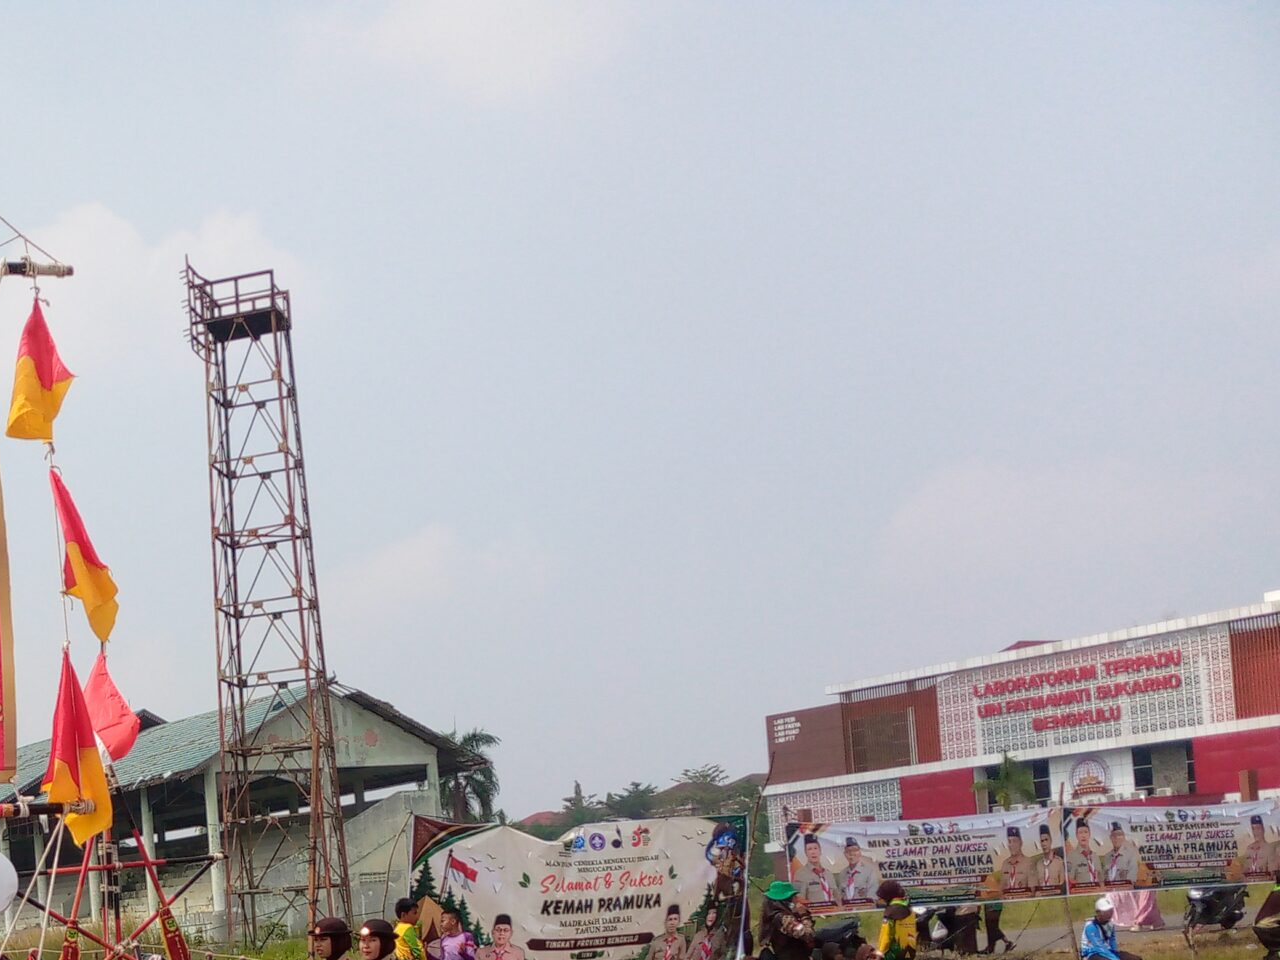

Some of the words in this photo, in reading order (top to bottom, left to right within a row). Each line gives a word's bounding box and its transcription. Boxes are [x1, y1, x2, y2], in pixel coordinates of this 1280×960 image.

[973, 664, 1096, 698] LABORATORIUM
[1102, 650, 1182, 677] TERPADU
[977, 702, 1002, 719] UIN
[1005, 687, 1091, 714] FATMAWATI
[1096, 673, 1181, 700] SUKARNO
[1032, 705, 1121, 732] BENGKULU
[1166, 821, 1220, 832] KEPAHIANG
[867, 839, 890, 849] MIN
[894, 838, 902, 848] 3
[904, 834, 971, 846] KEPAHIANG
[1145, 831, 1183, 842] SELAMAT
[1186, 830, 1203, 840] DAN
[1204, 829, 1235, 840] SUKSES
[885, 845, 929, 859] SELAMAT
[931, 845, 951, 855] DAN
[954, 842, 988, 854] SUKSES
[1138, 844, 1180, 855] KEMAH
[1183, 840, 1239, 854] PRAMUKA
[878, 859, 928, 872] KEMAH
[930, 854, 994, 868] PRAMUKA
[540, 873, 601, 895] Selamat
[601, 872, 614, 889] &
[619, 870, 664, 891] Sukses
[540, 897, 594, 916] KEMAH
[597, 893, 662, 913] PRAMUKA
[601, 915, 633, 926] DAERAH
[575, 926, 601, 935] TAHUN
[601, 924, 618, 933] 2026
[545, 939, 575, 949] TINGKAT
[575, 937, 607, 947] PROVINSI
